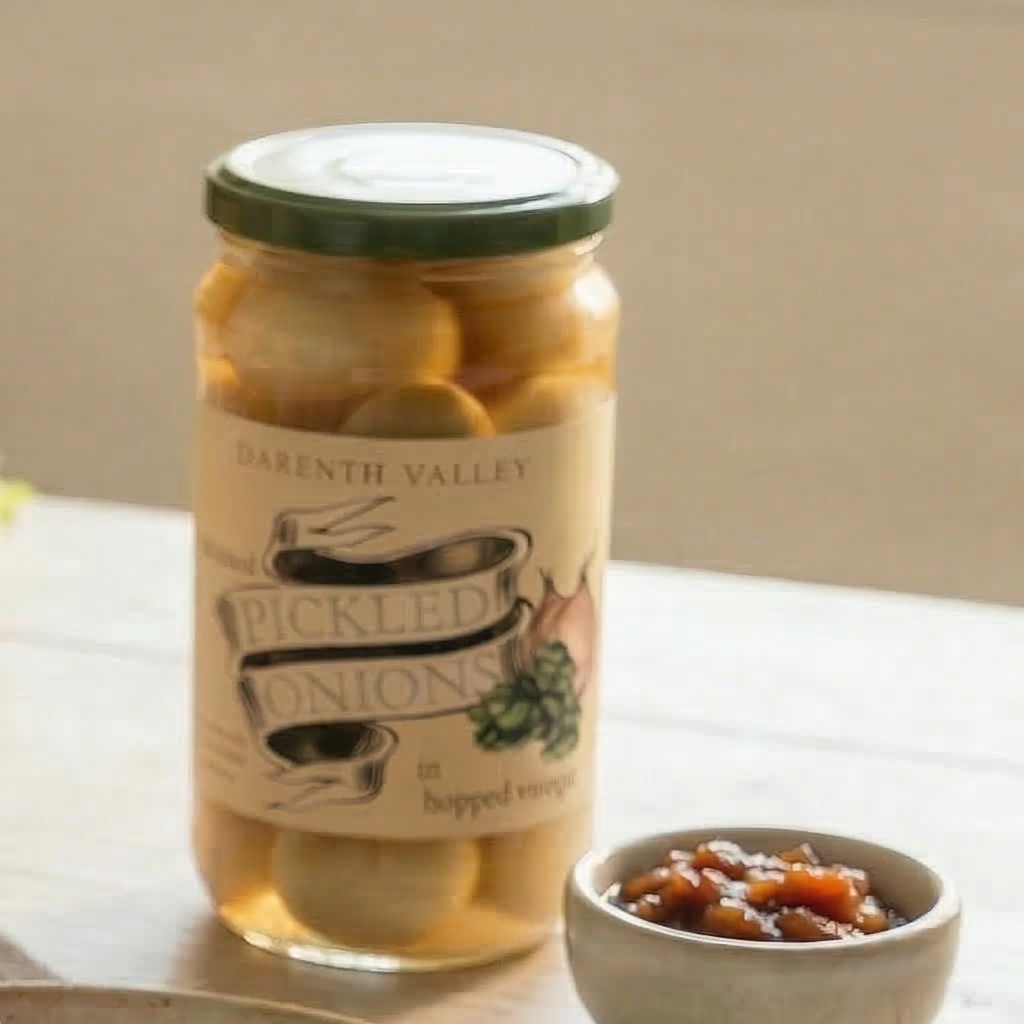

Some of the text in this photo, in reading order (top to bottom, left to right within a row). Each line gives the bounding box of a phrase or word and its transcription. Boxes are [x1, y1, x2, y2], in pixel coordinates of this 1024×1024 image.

[236, 441, 531, 486] DARENTH VALLEY
[240, 586, 489, 645] PICKLED
[264, 652, 501, 718] ONIONS
